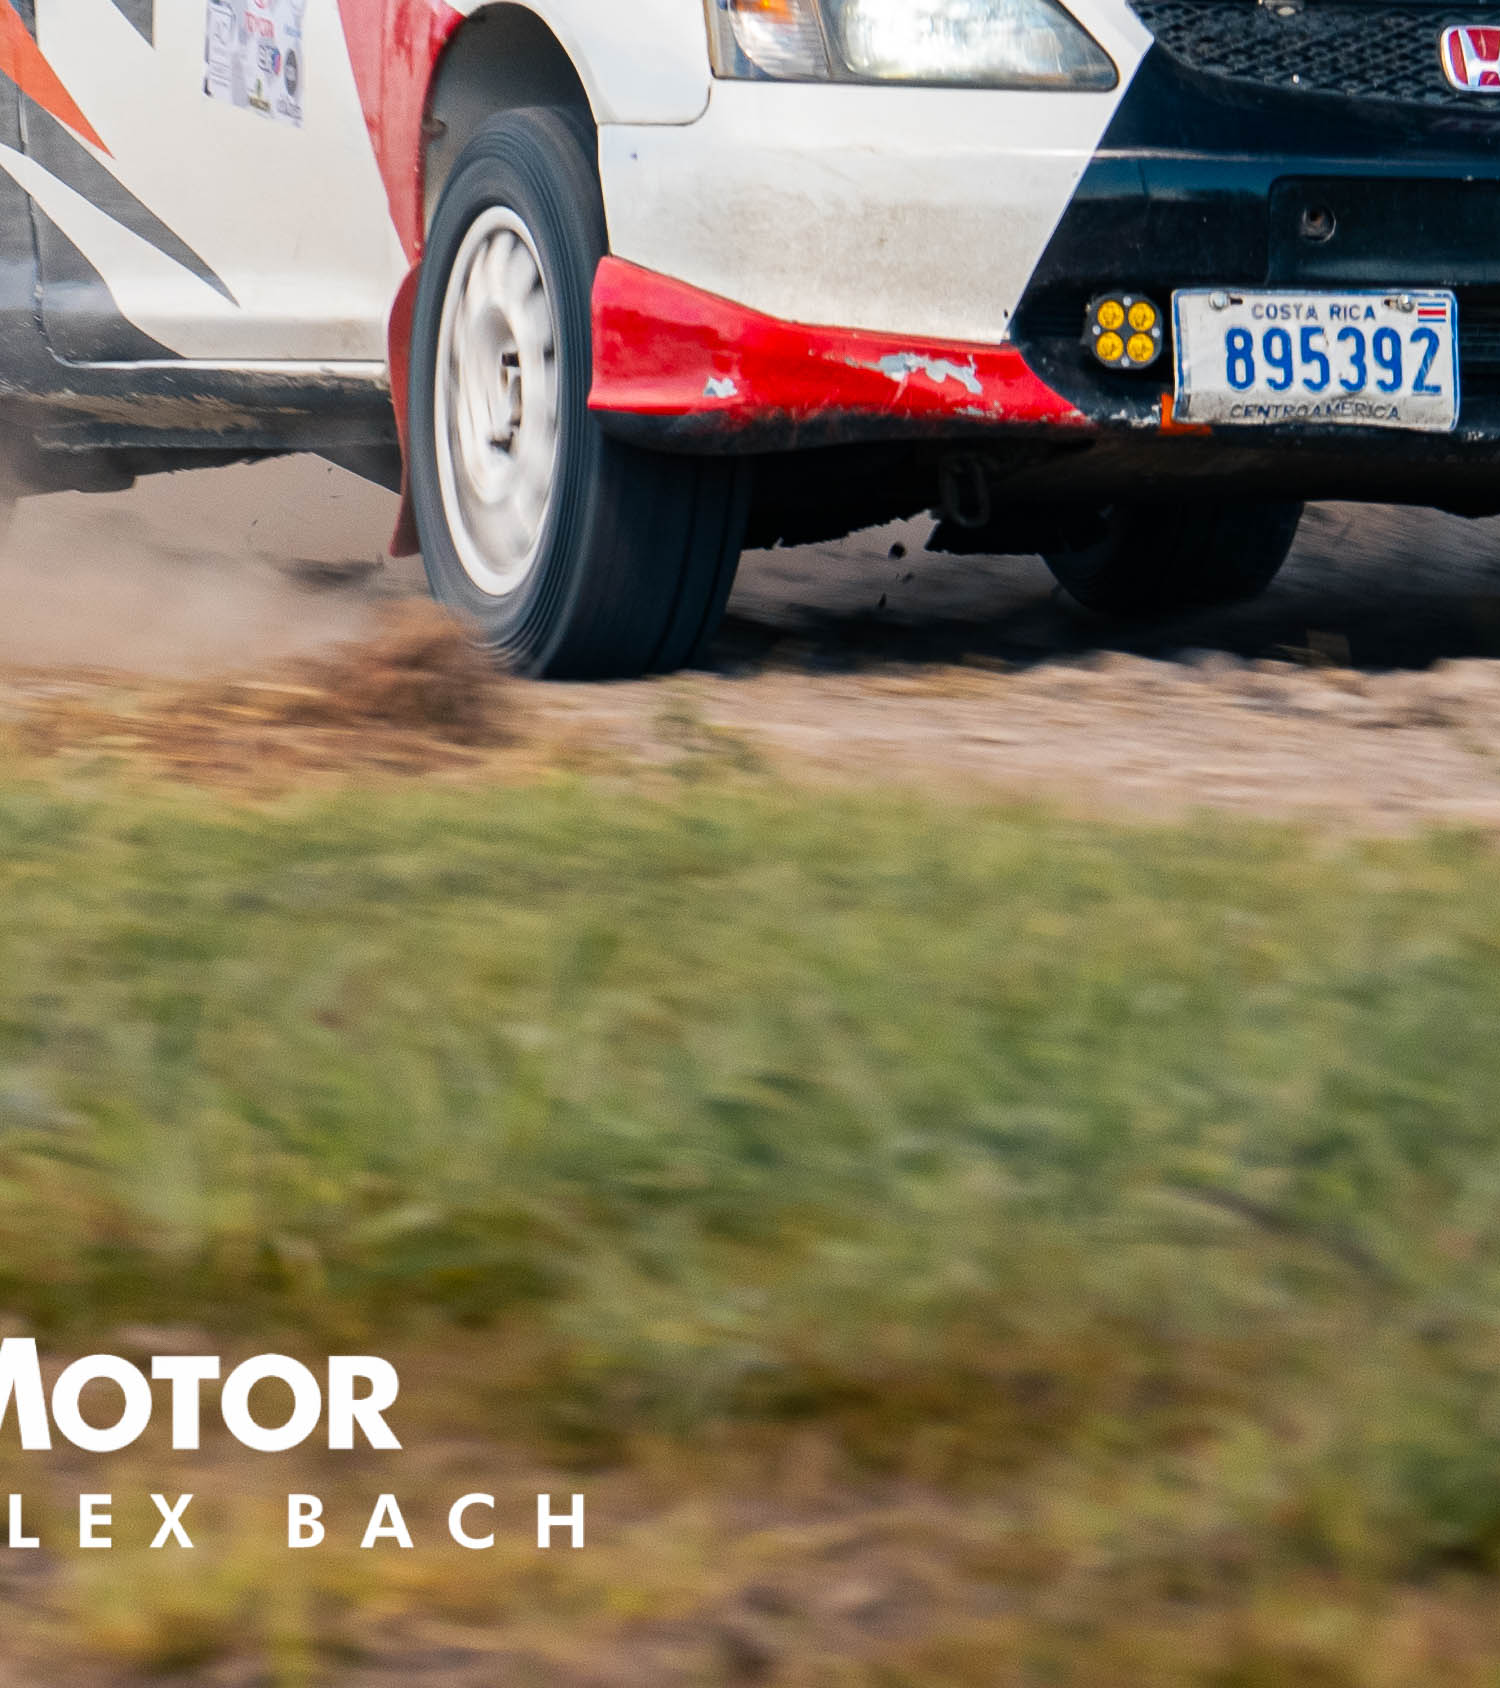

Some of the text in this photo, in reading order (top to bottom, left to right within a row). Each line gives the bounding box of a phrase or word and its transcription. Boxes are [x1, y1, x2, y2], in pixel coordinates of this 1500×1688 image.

[1252, 303, 1377, 321] COSTA RICA
[1225, 326, 1442, 396] 895392
[1230, 402, 1401, 420] CENTROAMERICA
